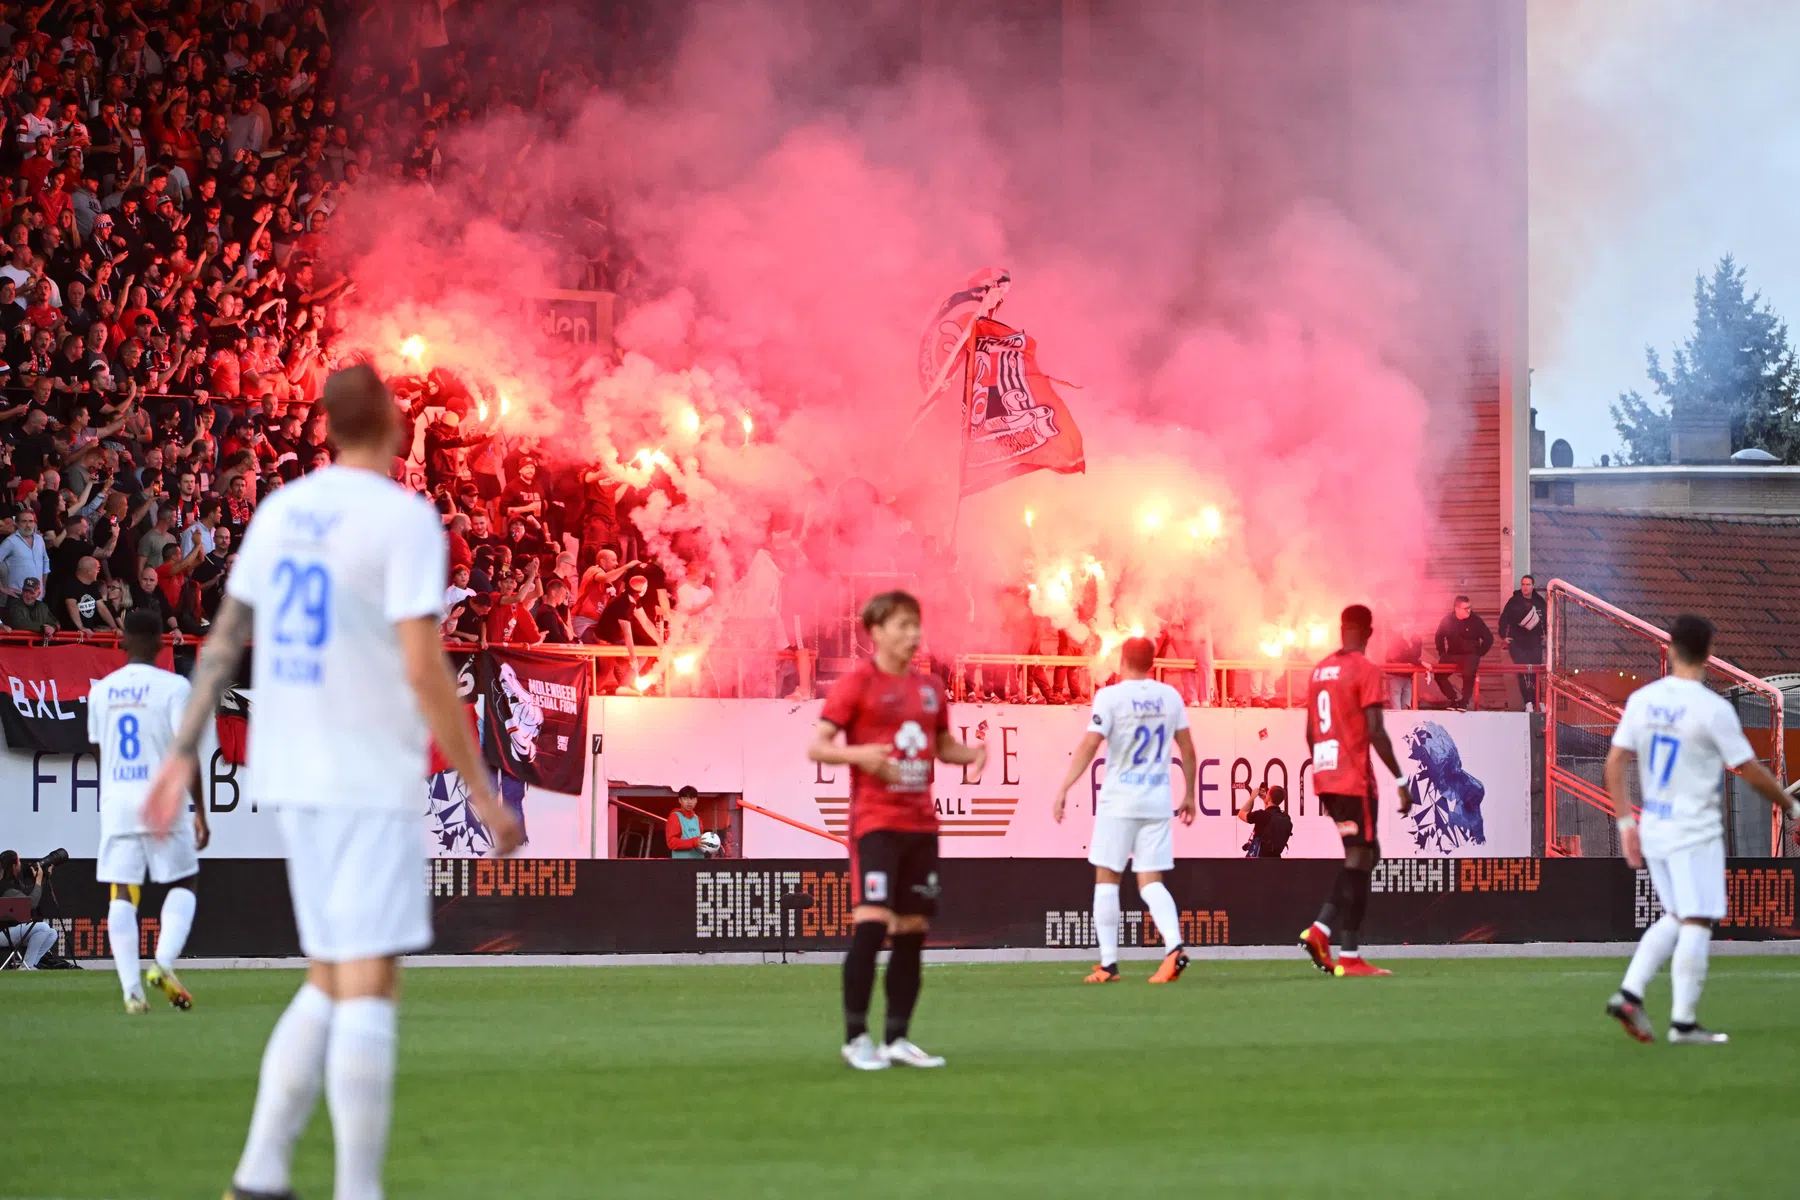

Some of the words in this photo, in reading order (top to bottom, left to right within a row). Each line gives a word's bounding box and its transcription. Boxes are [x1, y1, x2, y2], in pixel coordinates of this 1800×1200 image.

[273, 557, 331, 647] 29
[1317, 689, 1332, 734] 9
[117, 712, 140, 761] 8
[1132, 723, 1165, 766] 21
[1649, 732, 1681, 789] 17
